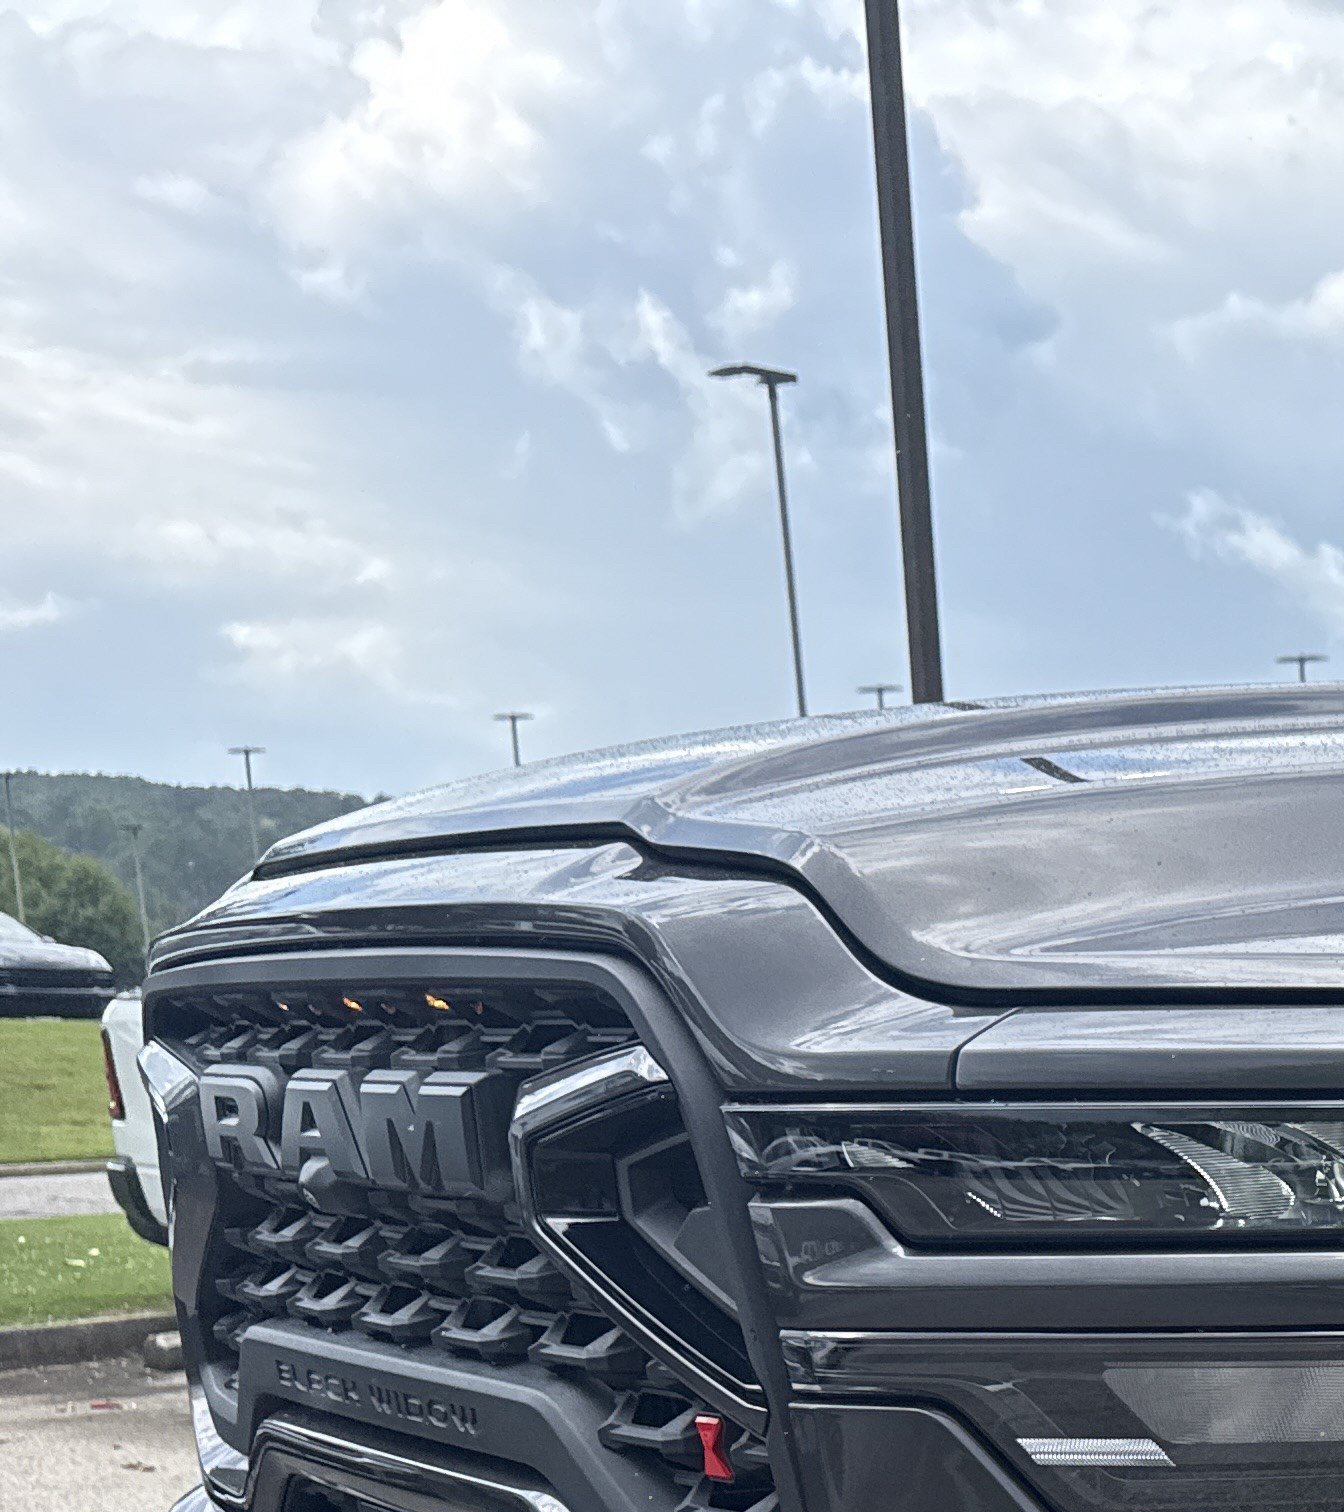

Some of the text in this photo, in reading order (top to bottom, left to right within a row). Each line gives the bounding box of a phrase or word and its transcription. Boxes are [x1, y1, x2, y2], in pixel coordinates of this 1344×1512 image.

[200, 1064, 483, 1192] RAM
[275, 1359, 478, 1436] BLACK WIDOW
